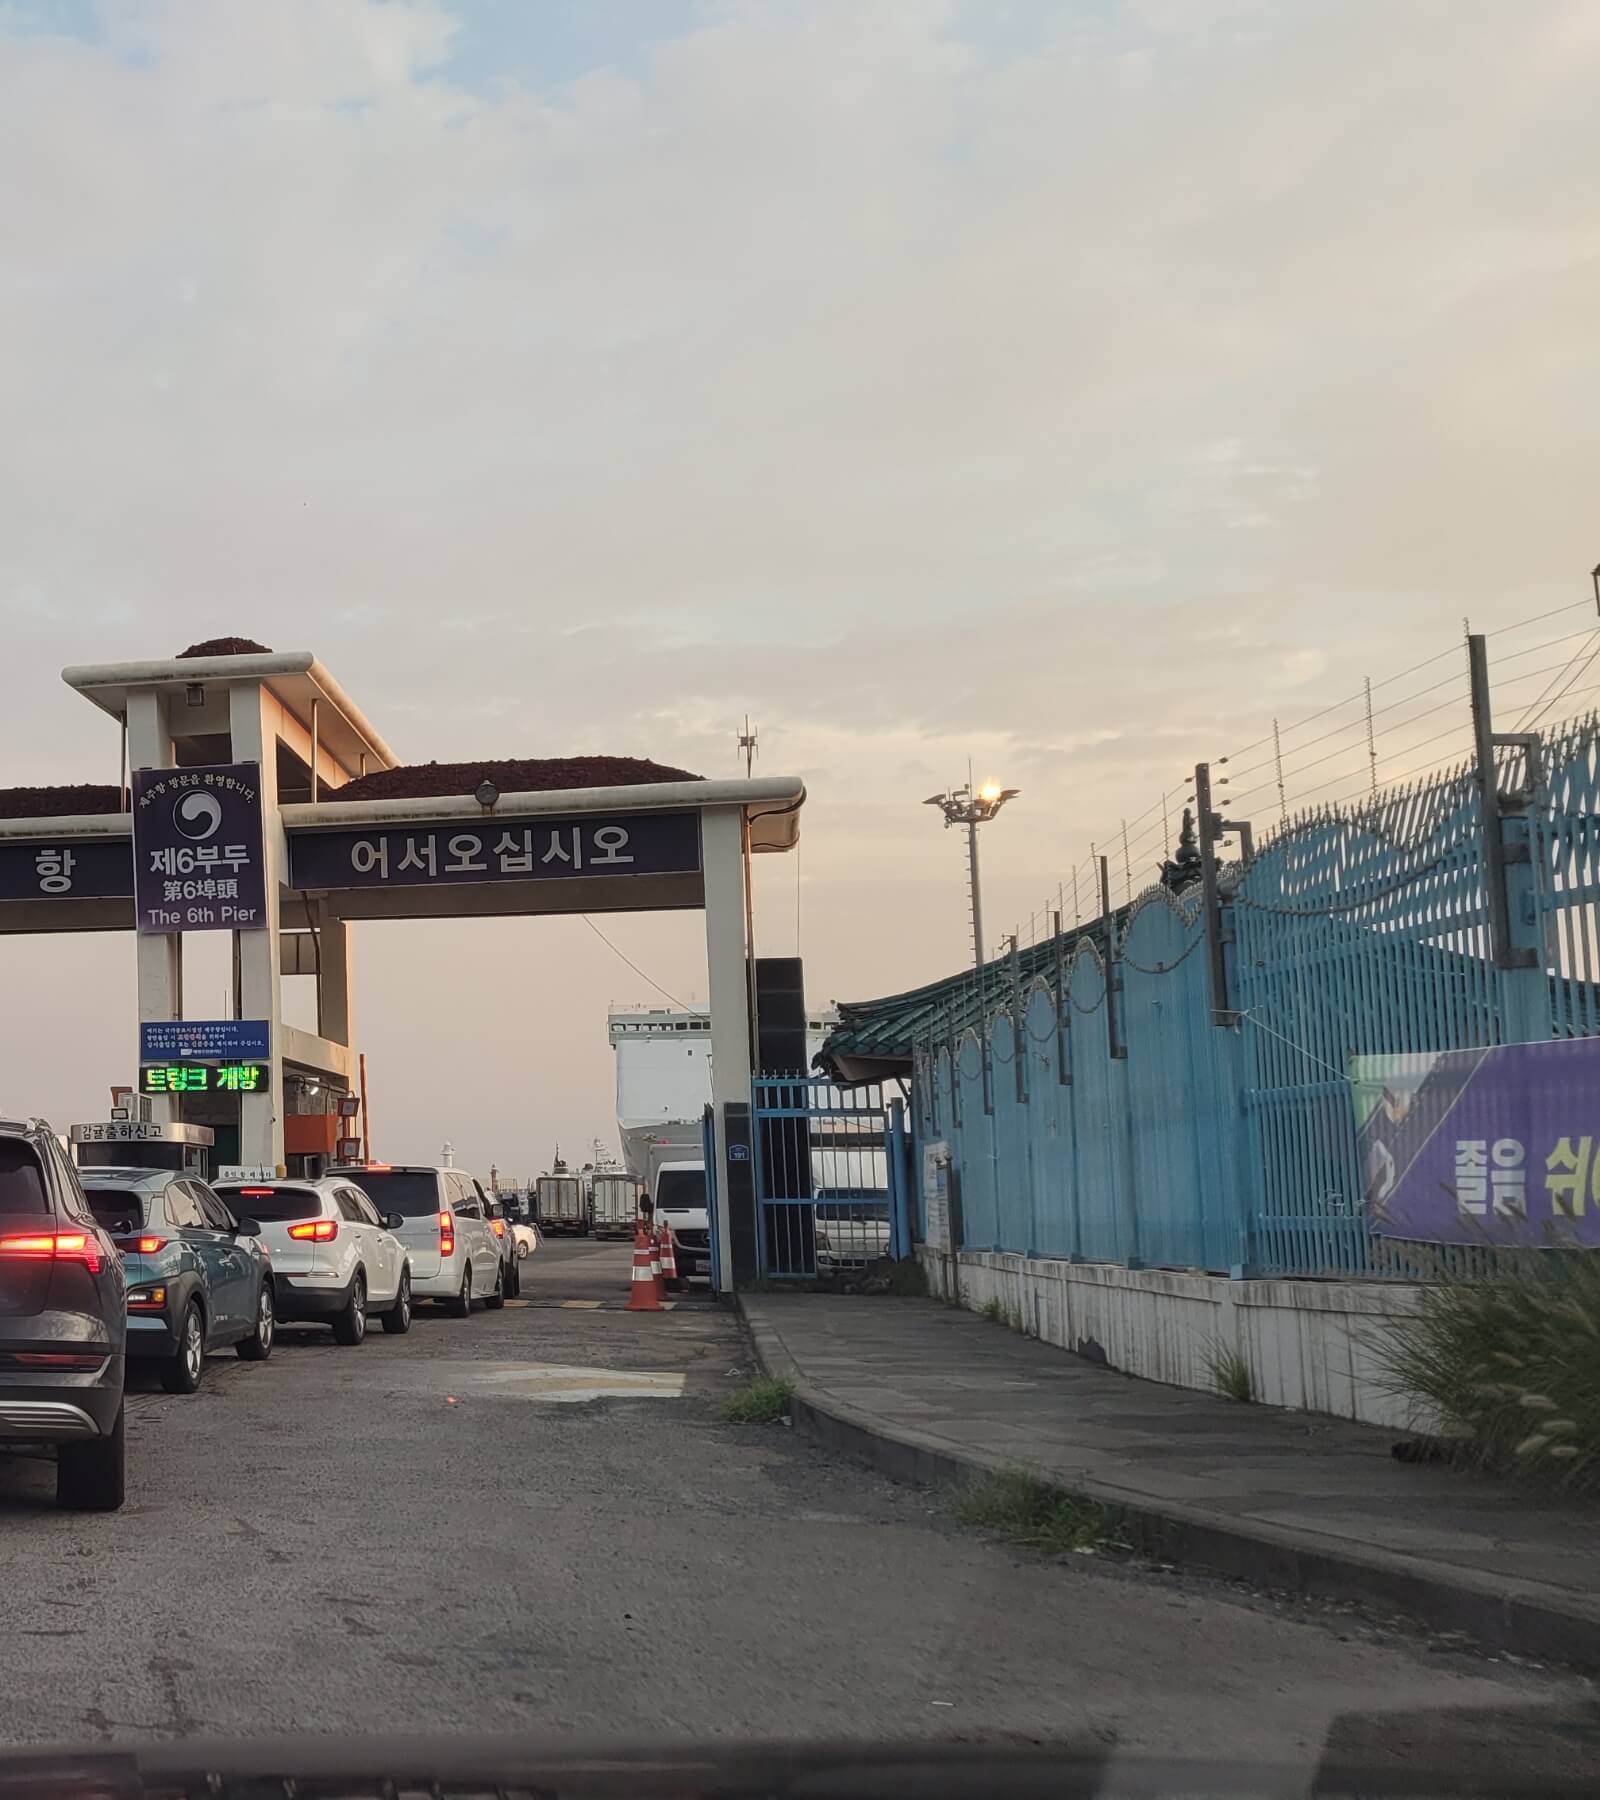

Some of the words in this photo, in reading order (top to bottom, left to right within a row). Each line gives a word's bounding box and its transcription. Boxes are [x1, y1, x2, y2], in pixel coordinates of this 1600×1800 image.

[139, 782, 166, 808] 제주항
[168, 774, 200, 788] 방문을
[204, 773, 255, 804] 환영합니다.
[149, 845, 251, 875] 제6부두
[350, 825, 635, 879] 어서오십시오
[162, 879, 239, 902] 第6埠頭
[147, 908, 181, 925] The
[186, 906, 214, 923] 6th
[221, 905, 257, 922] Pier
[145, 1066, 208, 1091] 트렁크
[216, 1066, 259, 1090] 개방
[82, 1124, 163, 1140] 감귤출하신고
[1455, 1138, 1527, 1216] 졸음
[1544, 1135, 1600, 1217] 쉬
